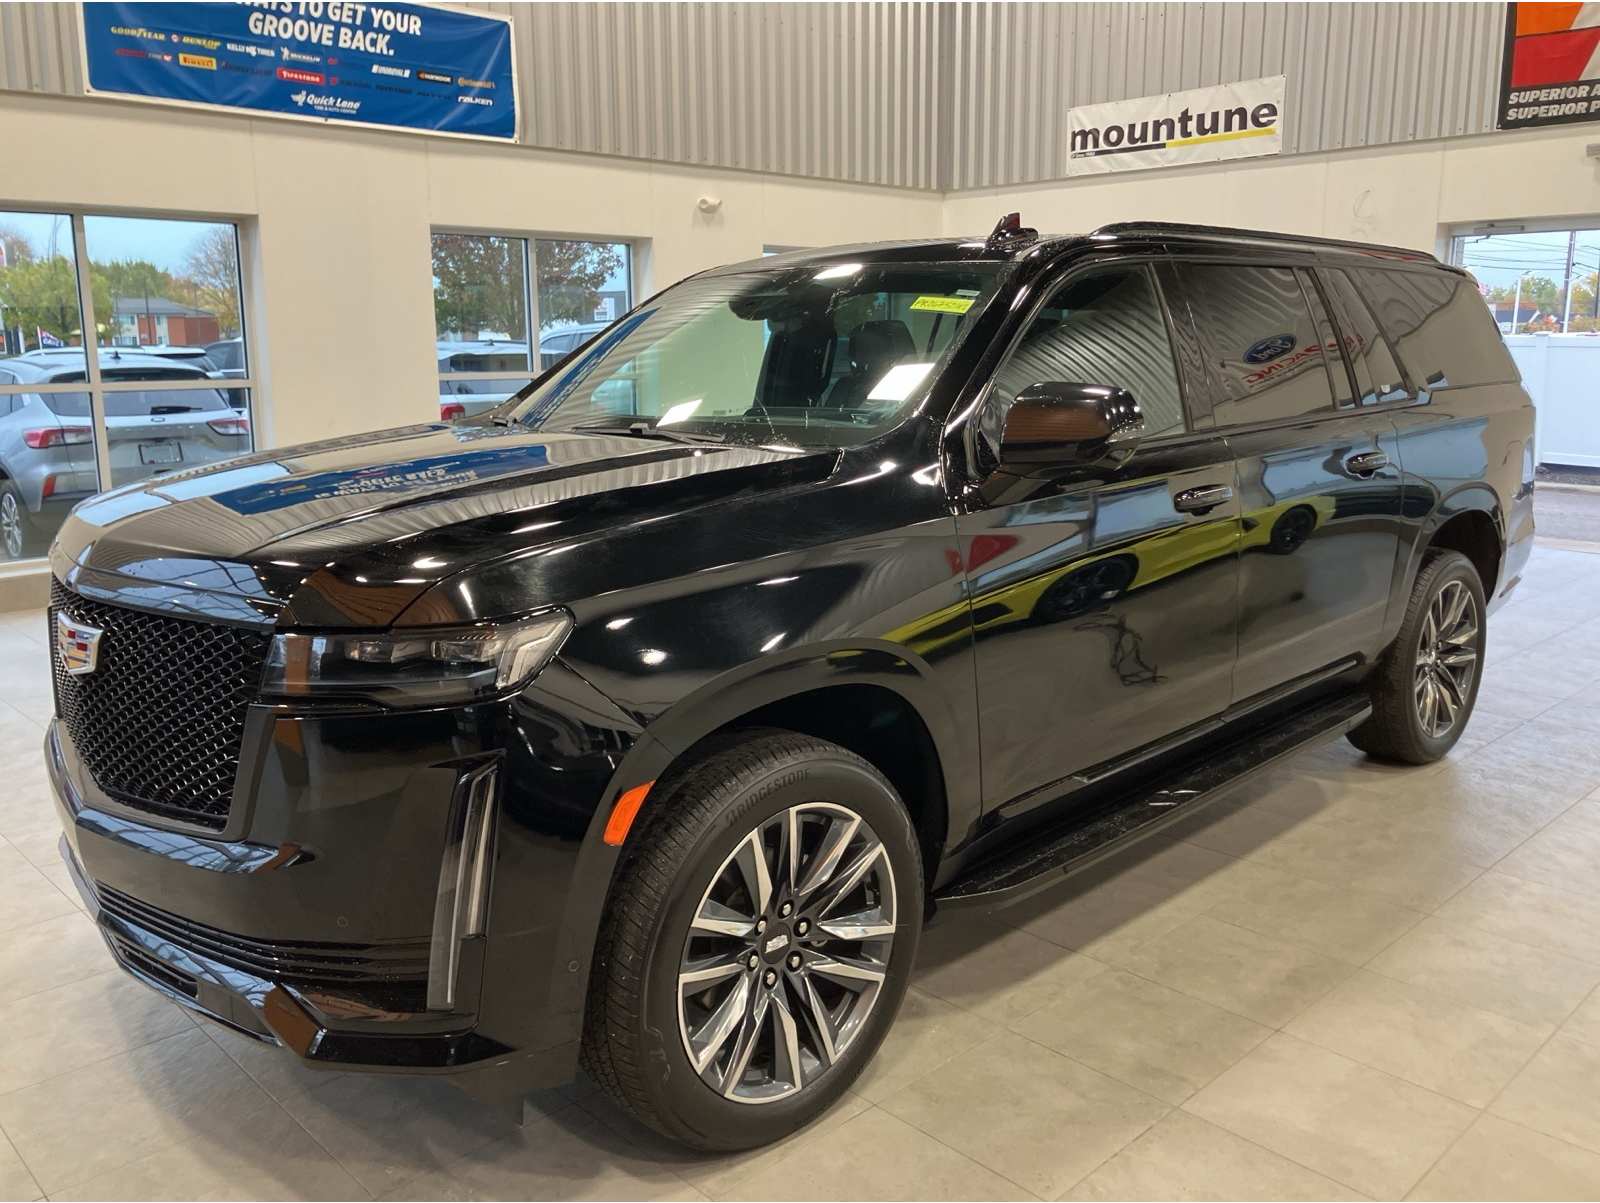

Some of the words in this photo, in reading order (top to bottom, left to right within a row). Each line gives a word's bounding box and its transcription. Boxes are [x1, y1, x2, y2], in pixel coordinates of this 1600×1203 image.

[328, 2, 366, 25] GET
[371, 8, 421, 36] YOUR
[249, 11, 335, 46] GROOVE
[338, 26, 395, 56] BACK.
[307, 93, 335, 108] Quick
[335, 96, 361, 110] Lane
[1508, 84, 1590, 105] SUPERIOR
[1506, 101, 1588, 120] SUPERIOR
[1070, 102, 1278, 152] mountune
